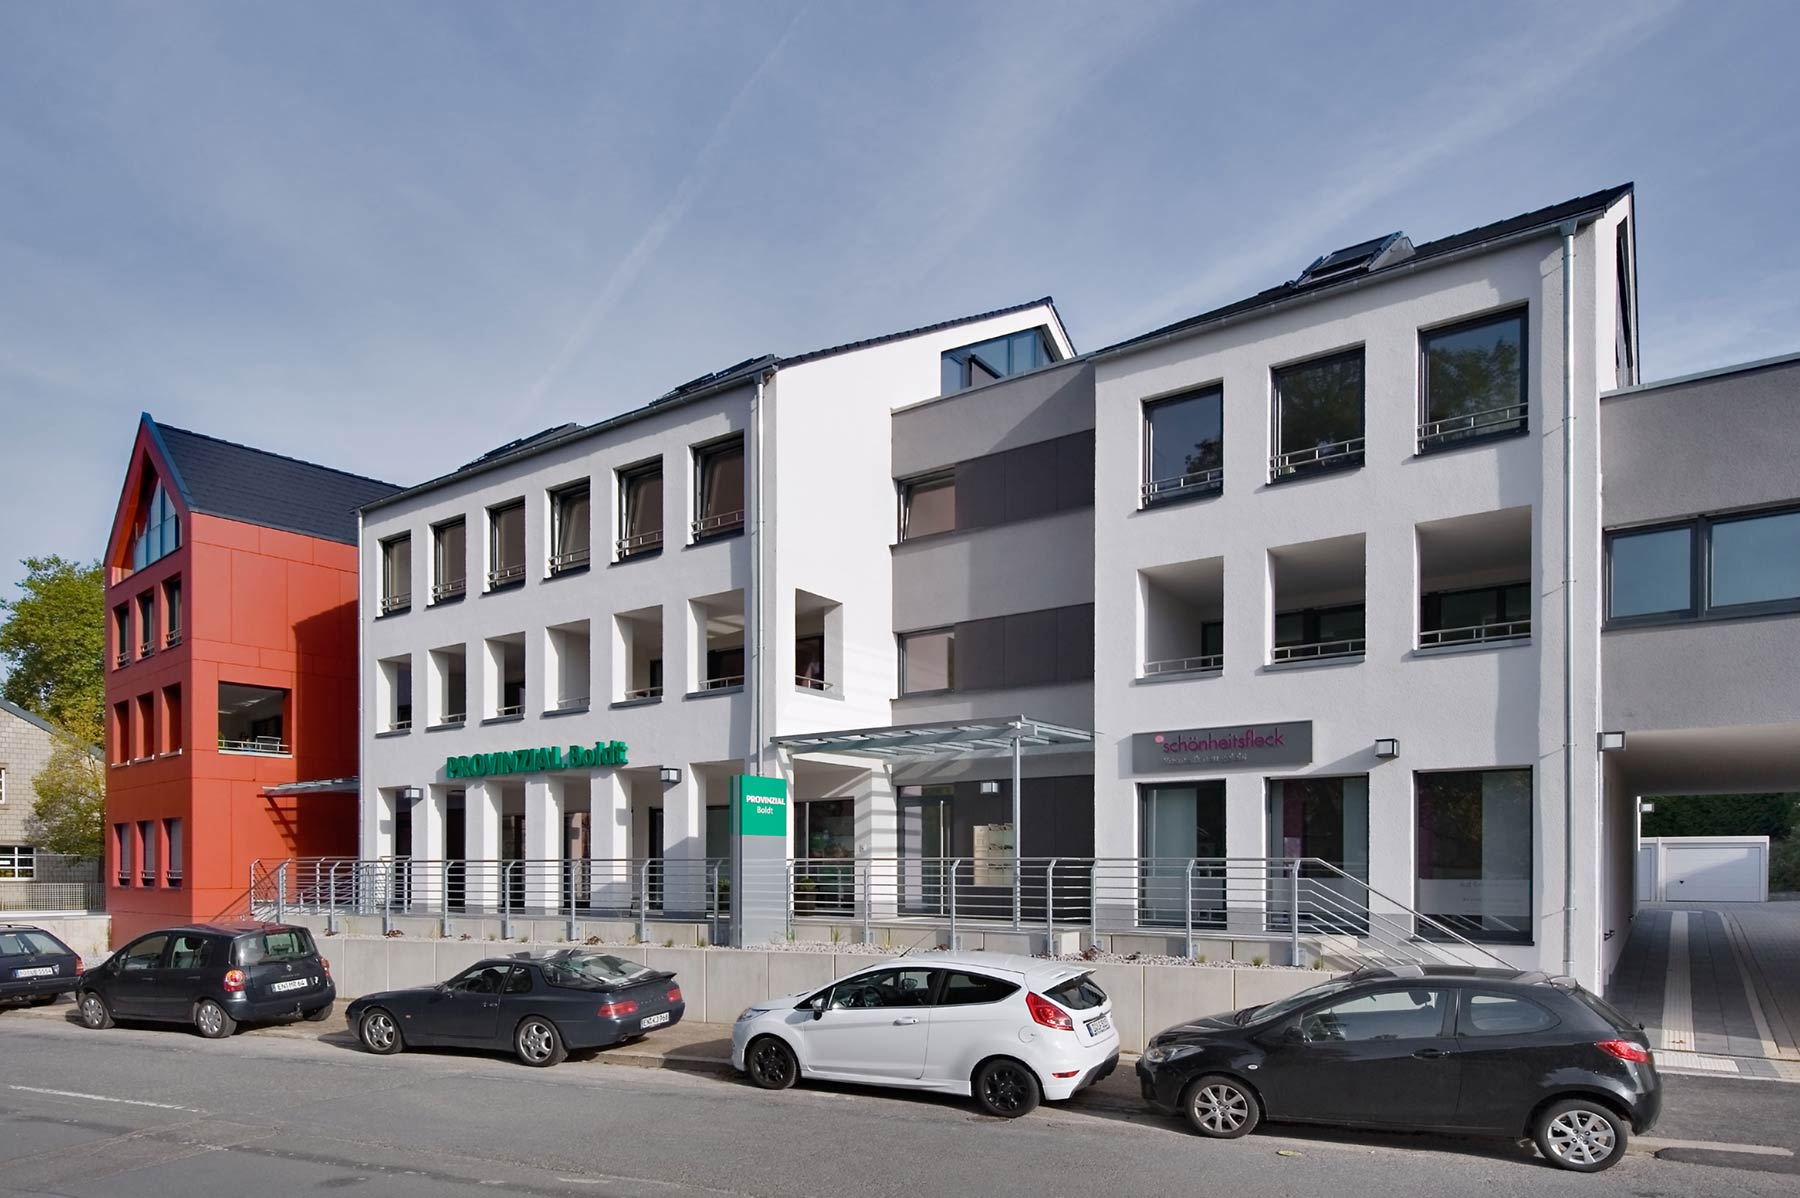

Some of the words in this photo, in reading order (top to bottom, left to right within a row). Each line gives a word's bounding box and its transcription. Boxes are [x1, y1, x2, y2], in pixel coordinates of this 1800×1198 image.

[1162, 727, 1285, 753] schönheitsfleck
[446, 746, 567, 778] PROVINZIAL
[569, 740, 629, 769] Boldt
[745, 794, 786, 806] PROVINZIAL
[756, 805, 774, 815] Boldt
